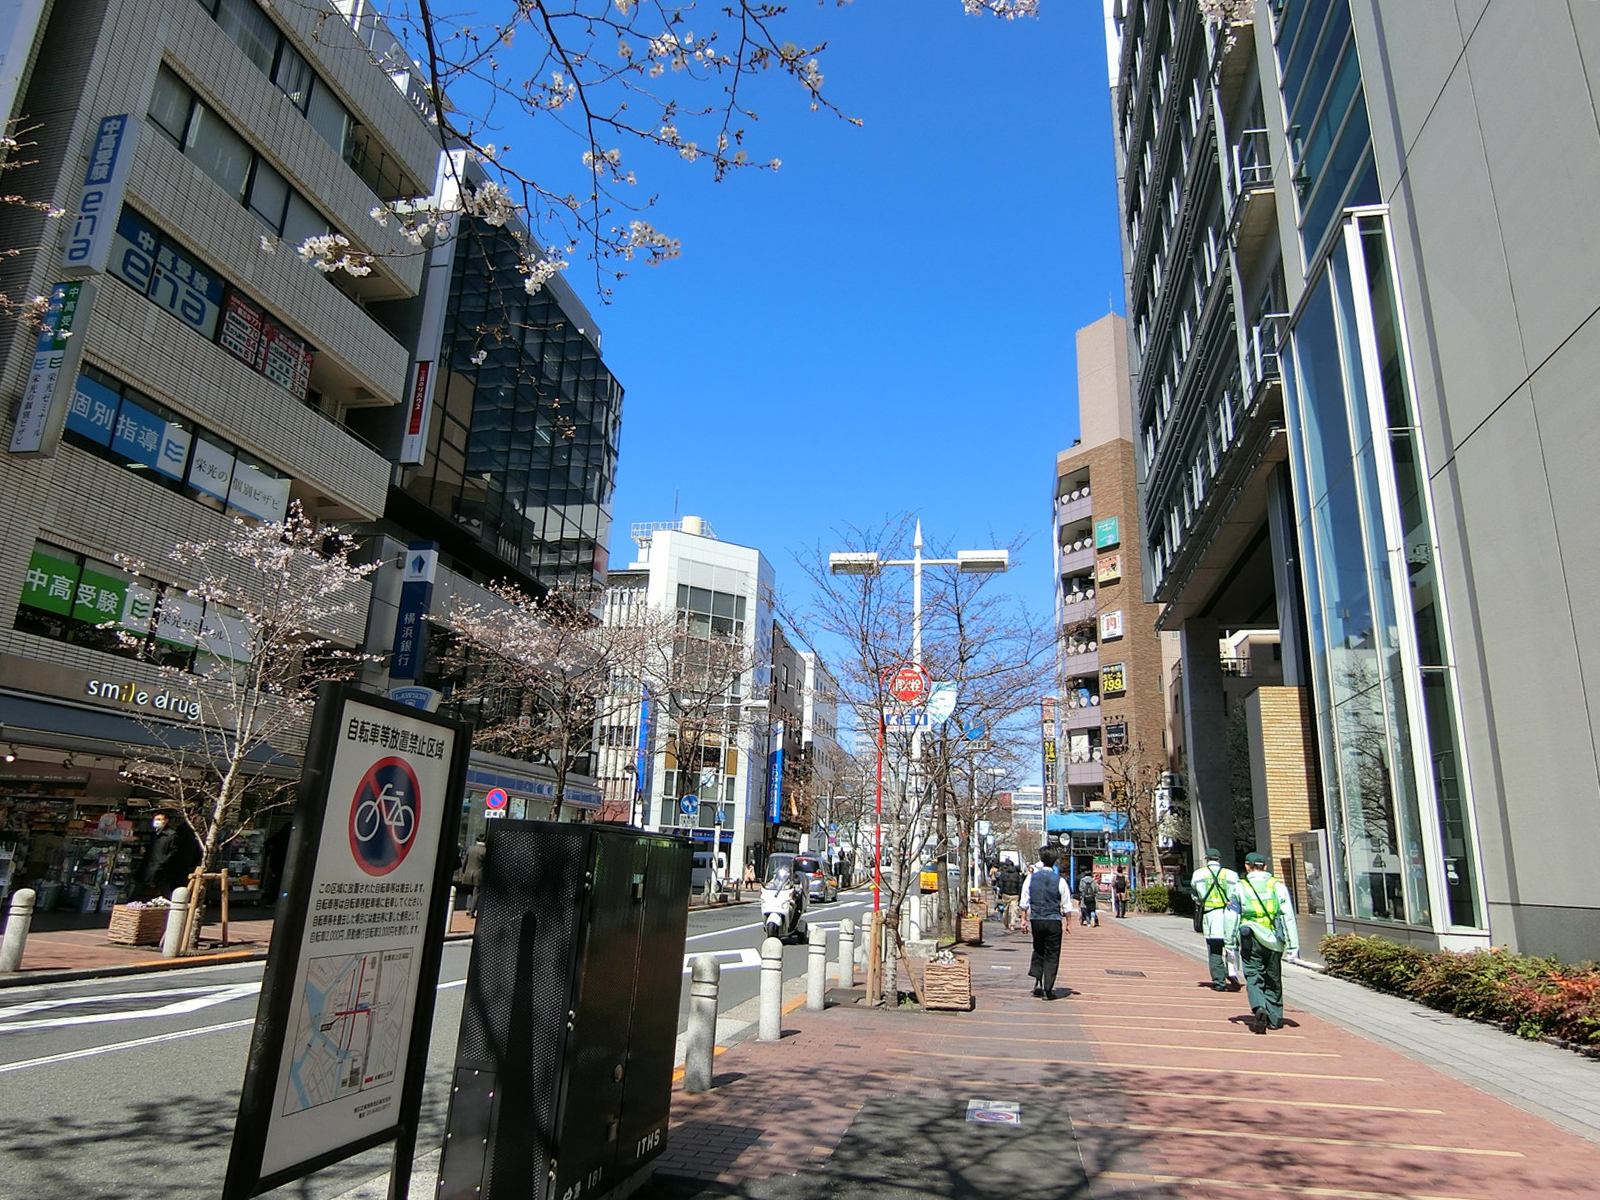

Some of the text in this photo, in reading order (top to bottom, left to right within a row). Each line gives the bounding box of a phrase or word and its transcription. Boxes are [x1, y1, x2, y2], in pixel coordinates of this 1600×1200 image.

[89, 119, 121, 181] 中高受験
[137, 229, 210, 296] 中高受験
[25, 567, 121, 616] 中高受験
[398, 612, 416, 667] 横浜銀行
[88, 679, 201, 720] smile drug
[395, 692, 428, 701] LAWSON
[348, 717, 445, 760] 自転車等放置禁止区域
